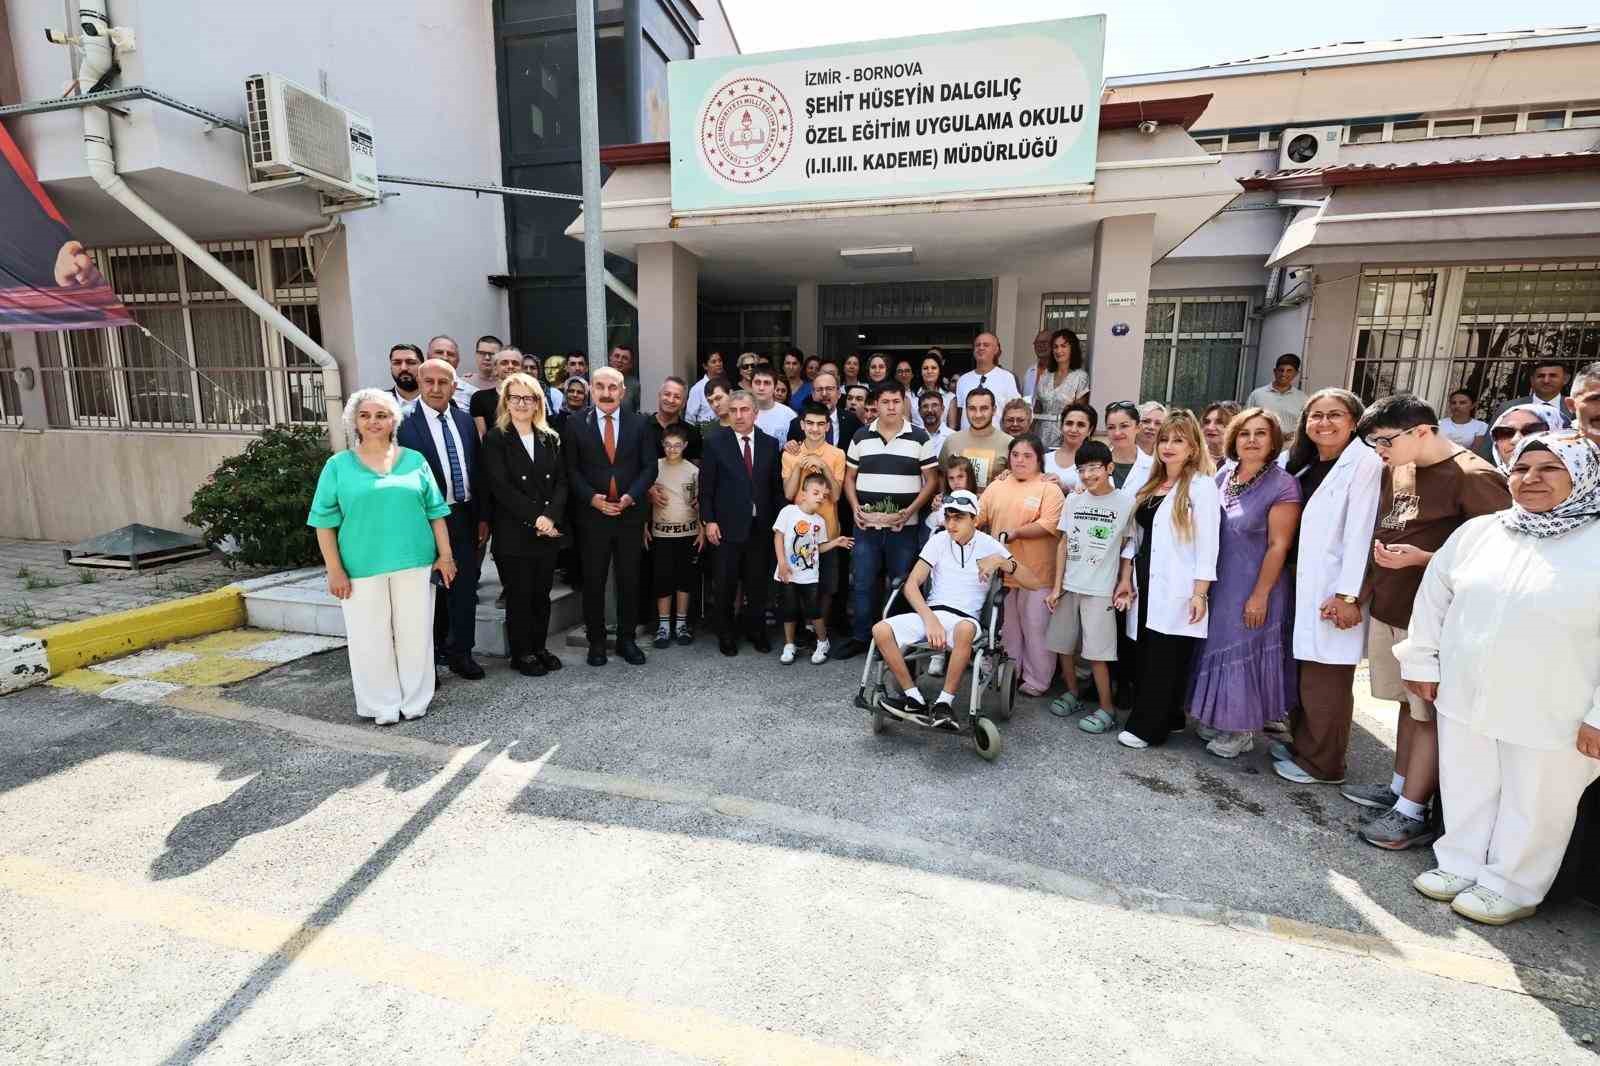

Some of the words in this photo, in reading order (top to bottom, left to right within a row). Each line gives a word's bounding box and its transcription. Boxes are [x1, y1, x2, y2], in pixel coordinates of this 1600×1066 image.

[805, 70, 841, 86] İZMİR
[854, 62, 922, 82] BORNOVA
[805, 90, 853, 118] ŞEHİT
[860, 82, 934, 112] HÜSEYİN
[941, 78, 1021, 104] DALGILIÇ
[805, 123, 847, 145] ÖZEL
[853, 118, 910, 142] EĞİTİM
[917, 113, 1013, 136] UYGULAMA
[1020, 105, 1083, 127] OKULU
[806, 153, 858, 179] (I.II.III.
[864, 149, 938, 171] KADEME)
[944, 136, 1058, 164] MÜDÜRLÜĞÜ
